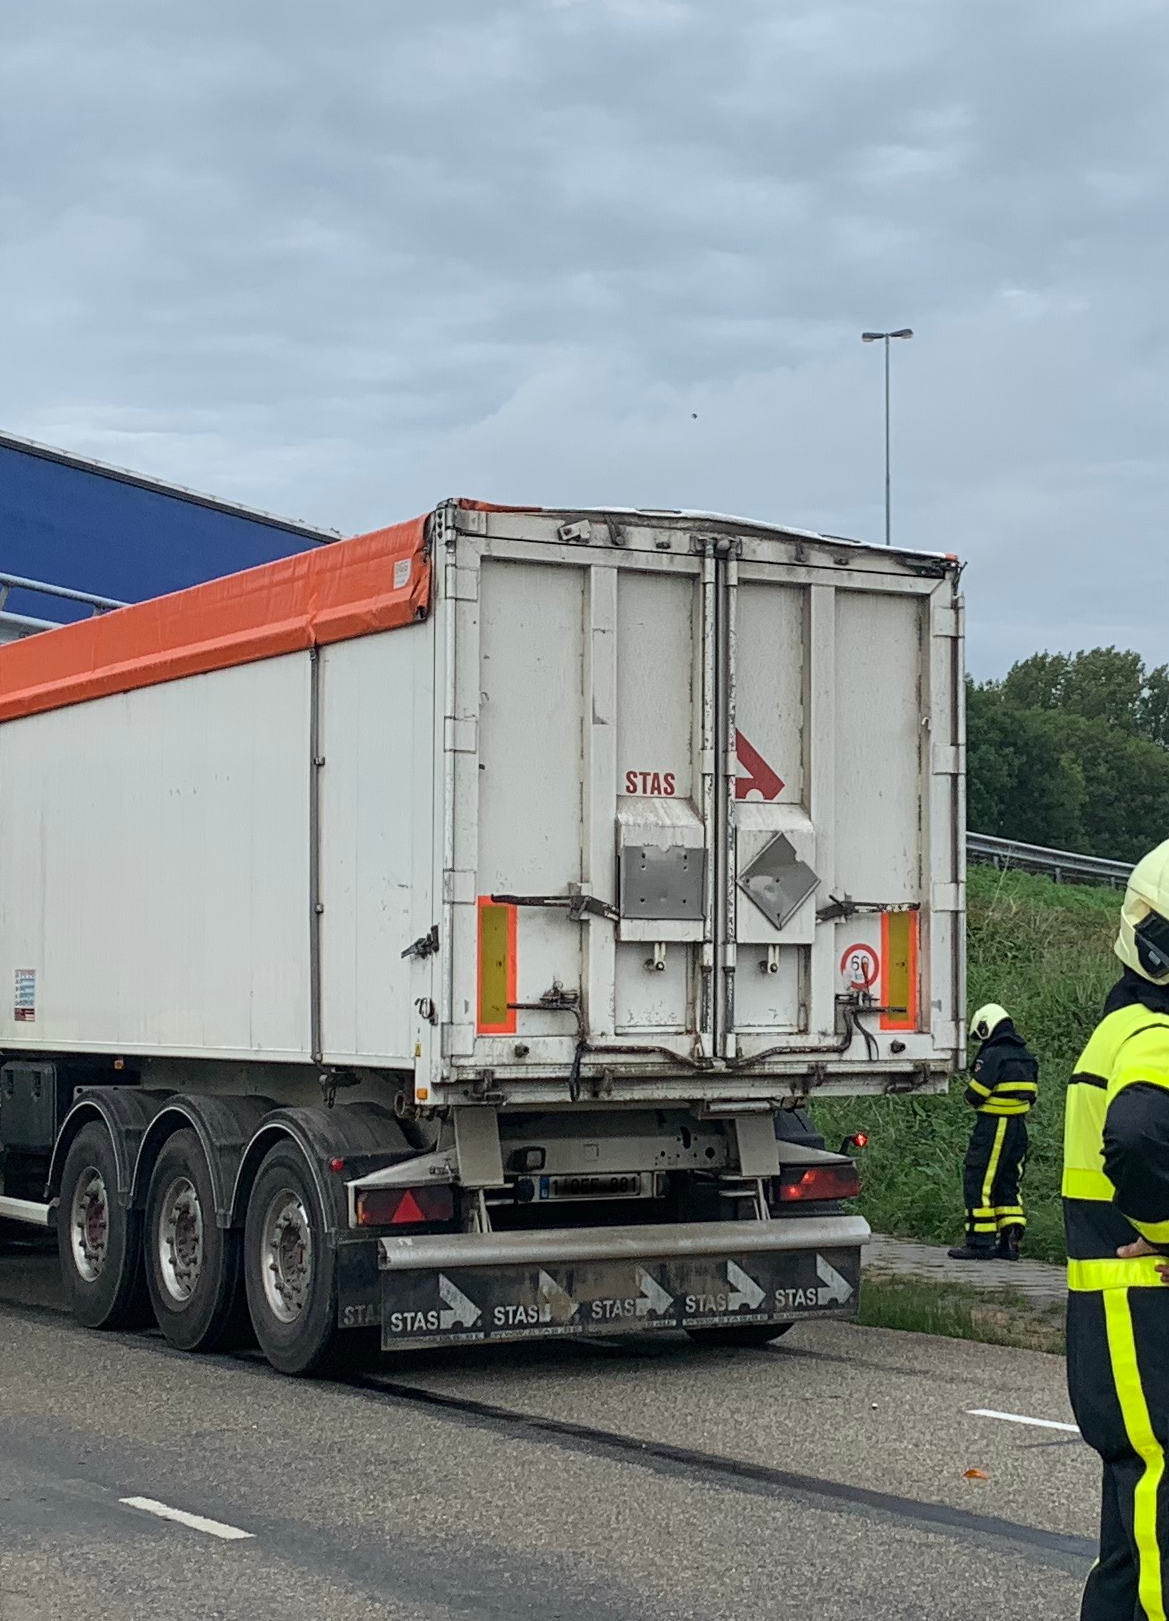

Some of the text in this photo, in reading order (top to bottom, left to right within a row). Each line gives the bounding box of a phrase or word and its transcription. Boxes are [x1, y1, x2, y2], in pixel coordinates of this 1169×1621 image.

[625, 770, 676, 796] STAS
[685, 1294, 730, 1314] STAS
[775, 1288, 817, 1307] STAS
[493, 1303, 538, 1325] STAS
[591, 1299, 634, 1319] STAS
[390, 1310, 439, 1333] STAS
